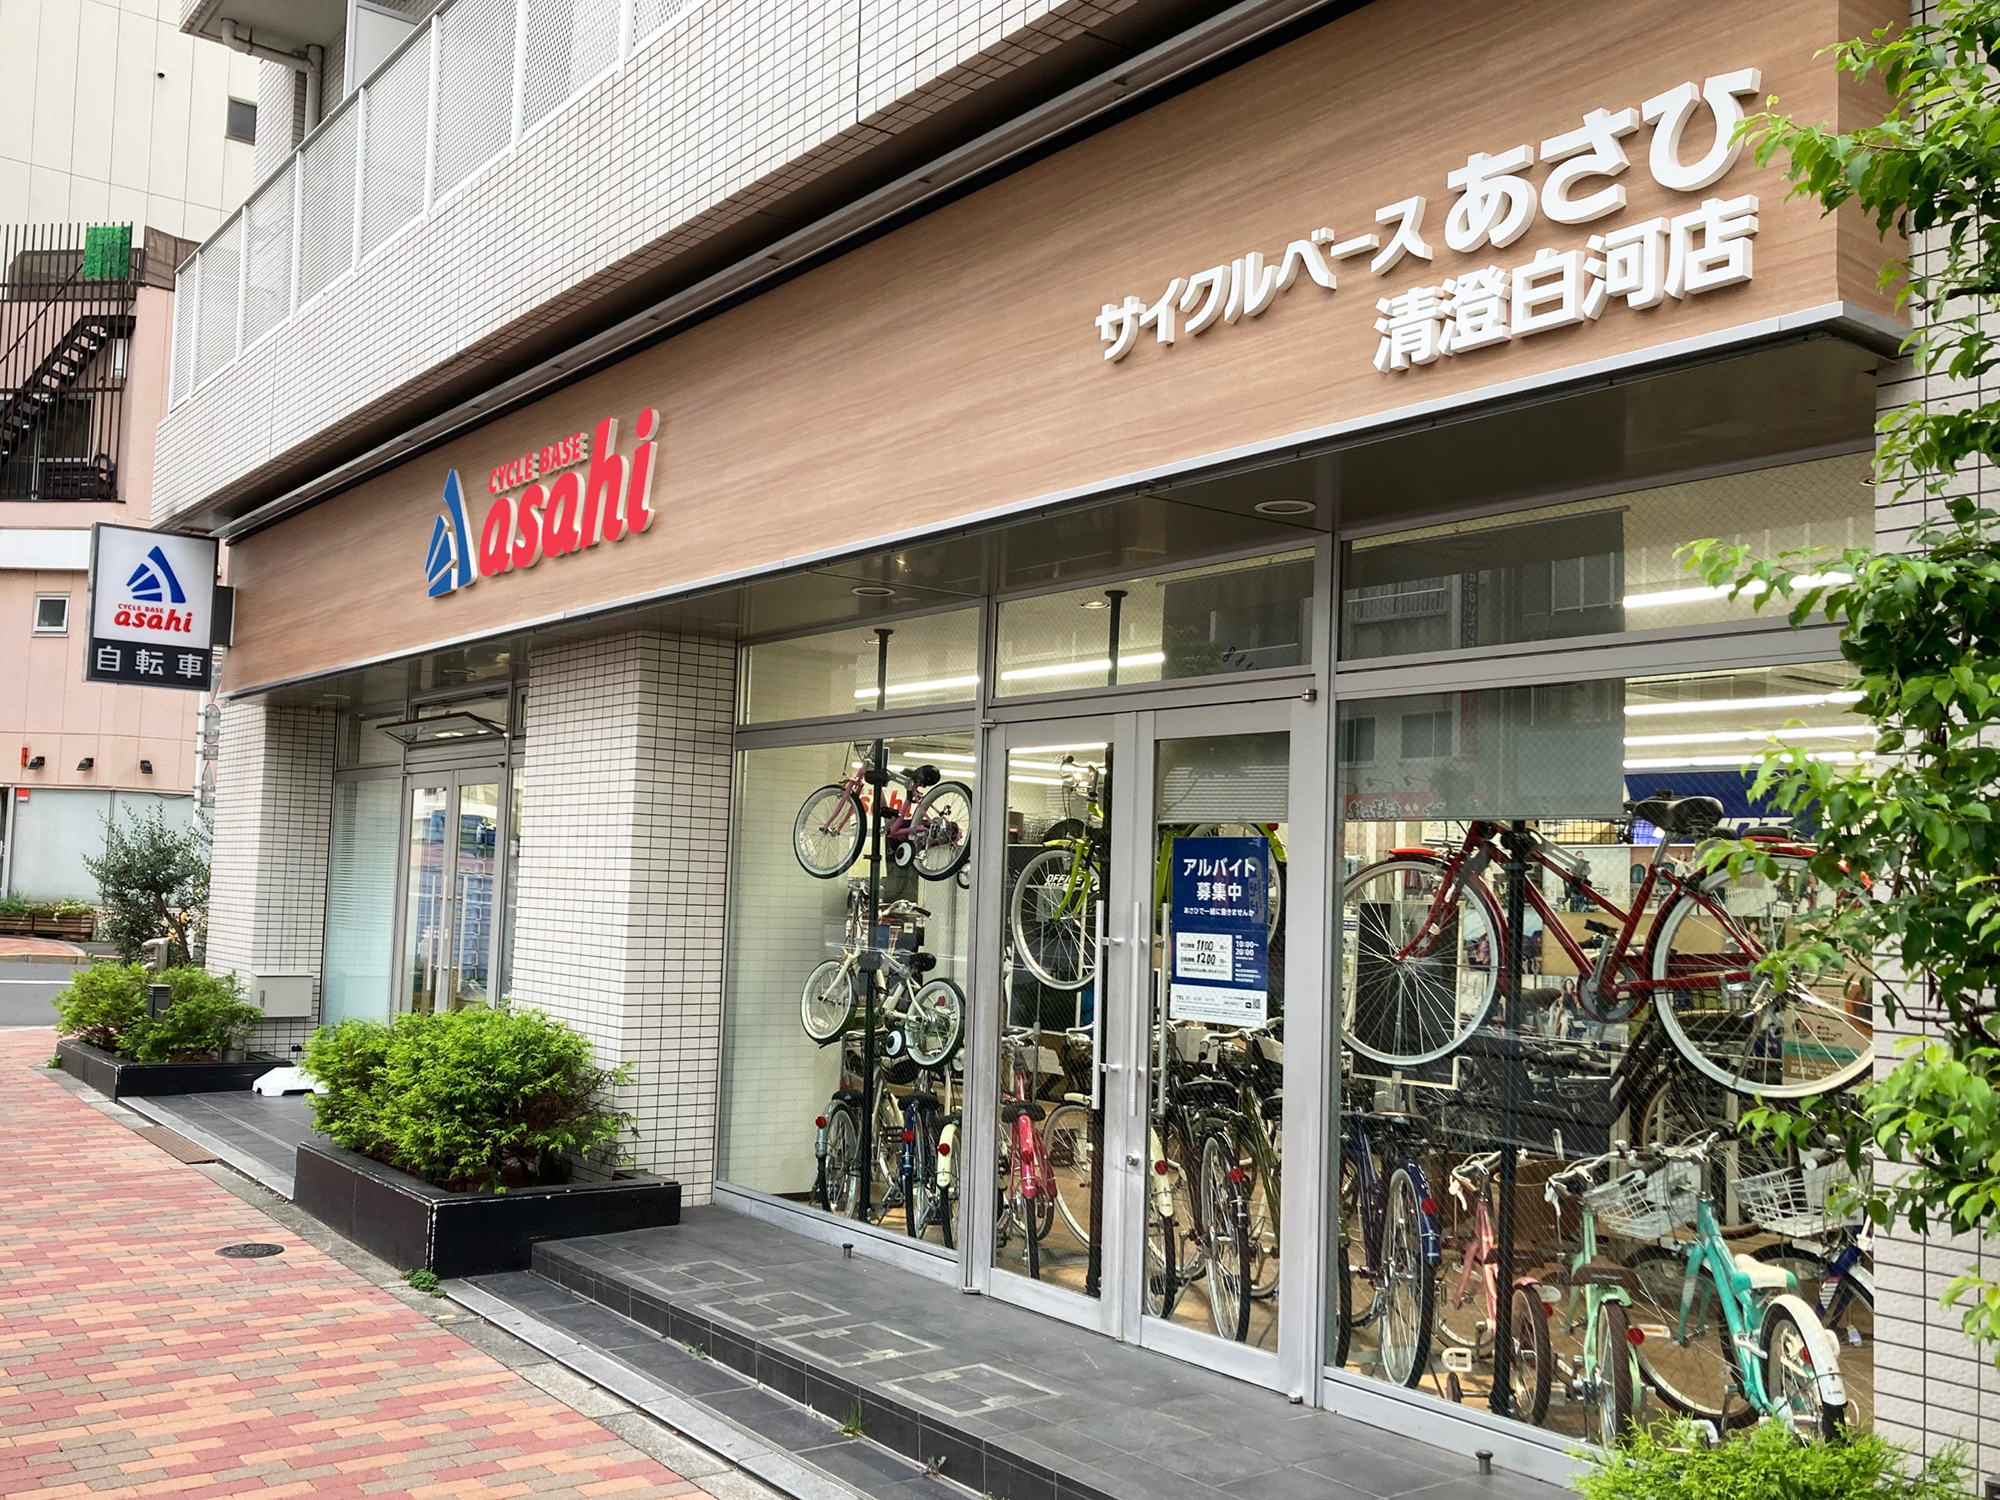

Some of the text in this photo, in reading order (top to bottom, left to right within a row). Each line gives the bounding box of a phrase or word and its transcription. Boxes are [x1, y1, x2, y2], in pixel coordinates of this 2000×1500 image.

[1095, 67, 1762, 361] サイクルベース あさひ
[1373, 194, 1759, 373] 清澄白河店
[488, 432, 588, 494] CYCLE BASE
[479, 407, 659, 577] asahi
[118, 603, 164, 614] CYCLE BASE
[114, 609, 193, 633] asahi
[97, 645, 203, 679] 自転車
[1183, 857, 1256, 878] アルバイト
[1196, 882, 1242, 902] 募集中
[1196, 940, 1214, 951] 1100
[1235, 948, 1254, 956] 20:00
[1196, 952, 1216, 965] 1200
